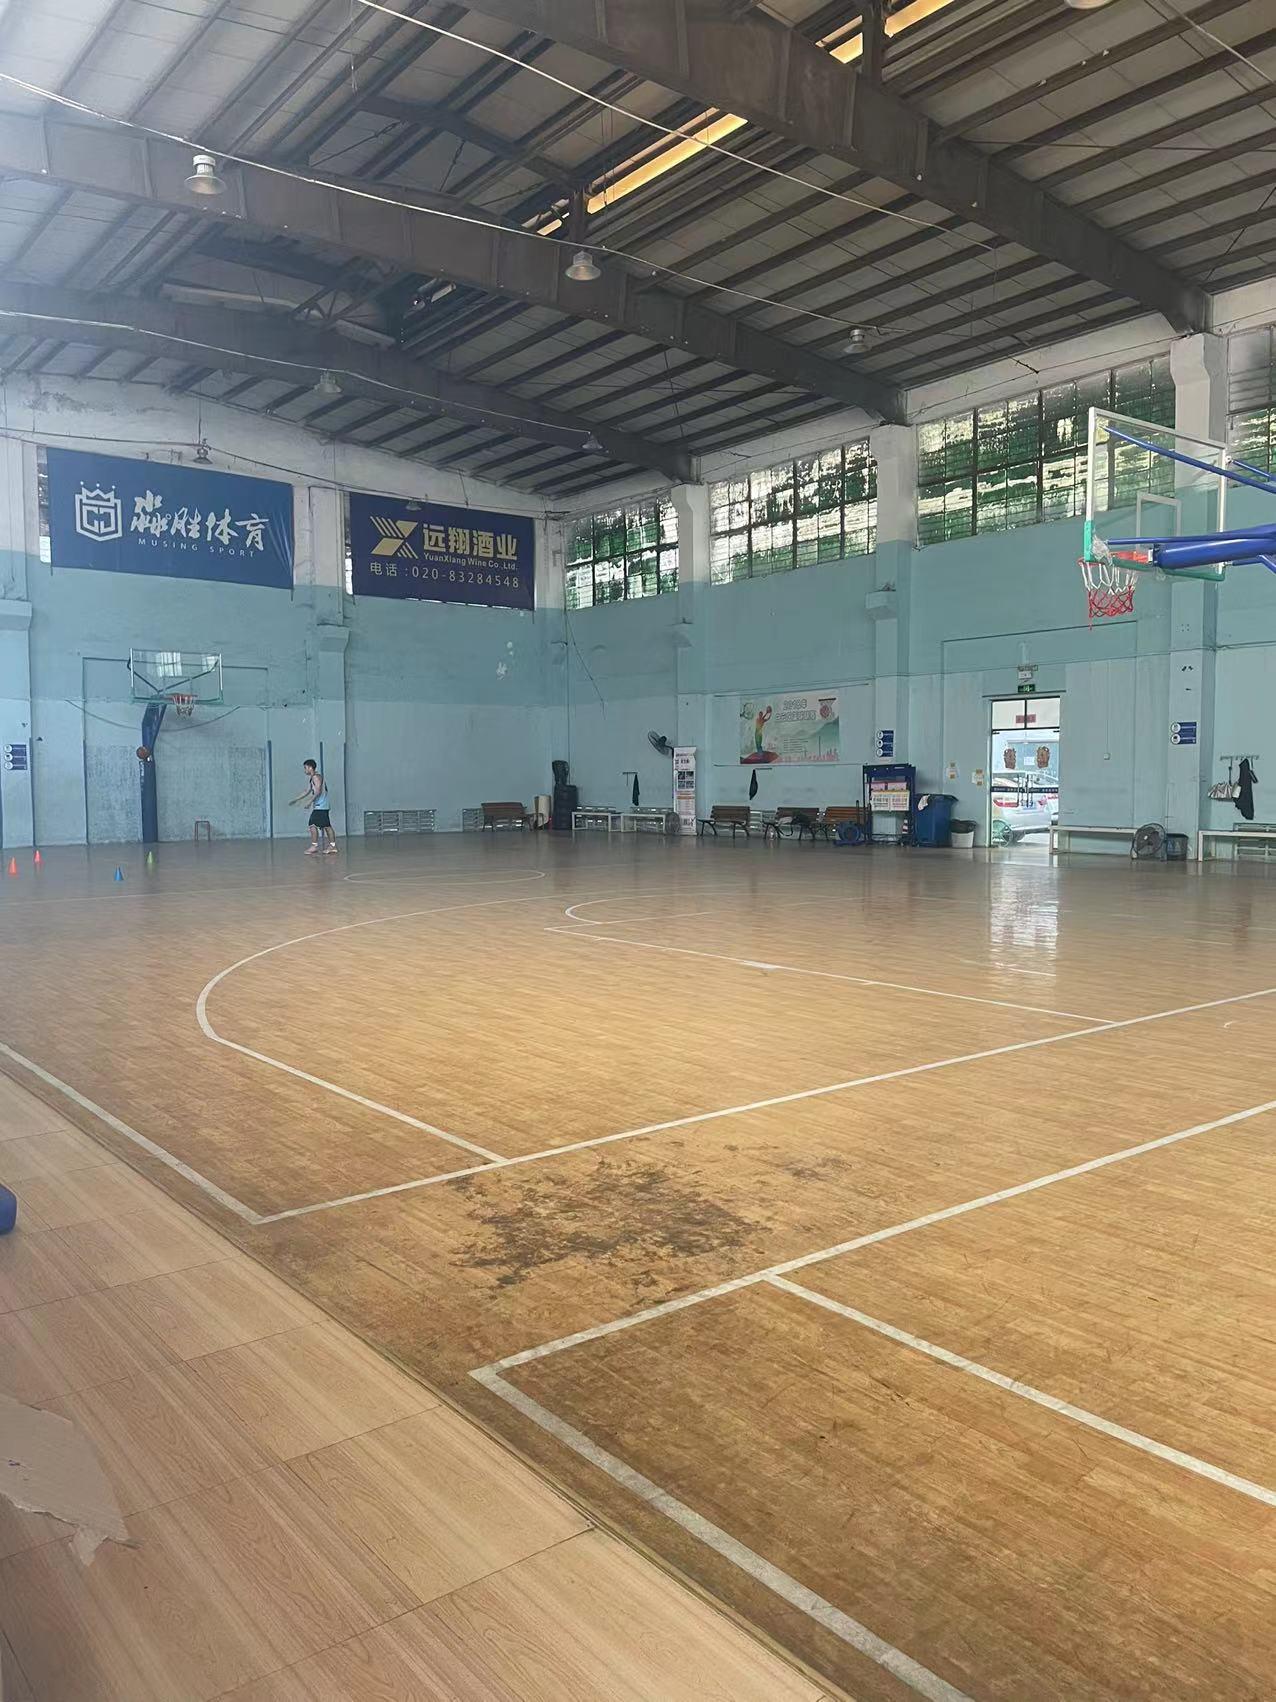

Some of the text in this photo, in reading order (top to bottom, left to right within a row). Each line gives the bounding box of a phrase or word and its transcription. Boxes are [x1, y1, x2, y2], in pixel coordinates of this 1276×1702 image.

[138, 539, 255, 558] MUSING SPORT
[423, 523, 518, 561] 远翔酒业
[423, 552, 467, 566] YuanXiang
[467, 557, 487, 567] Wine
